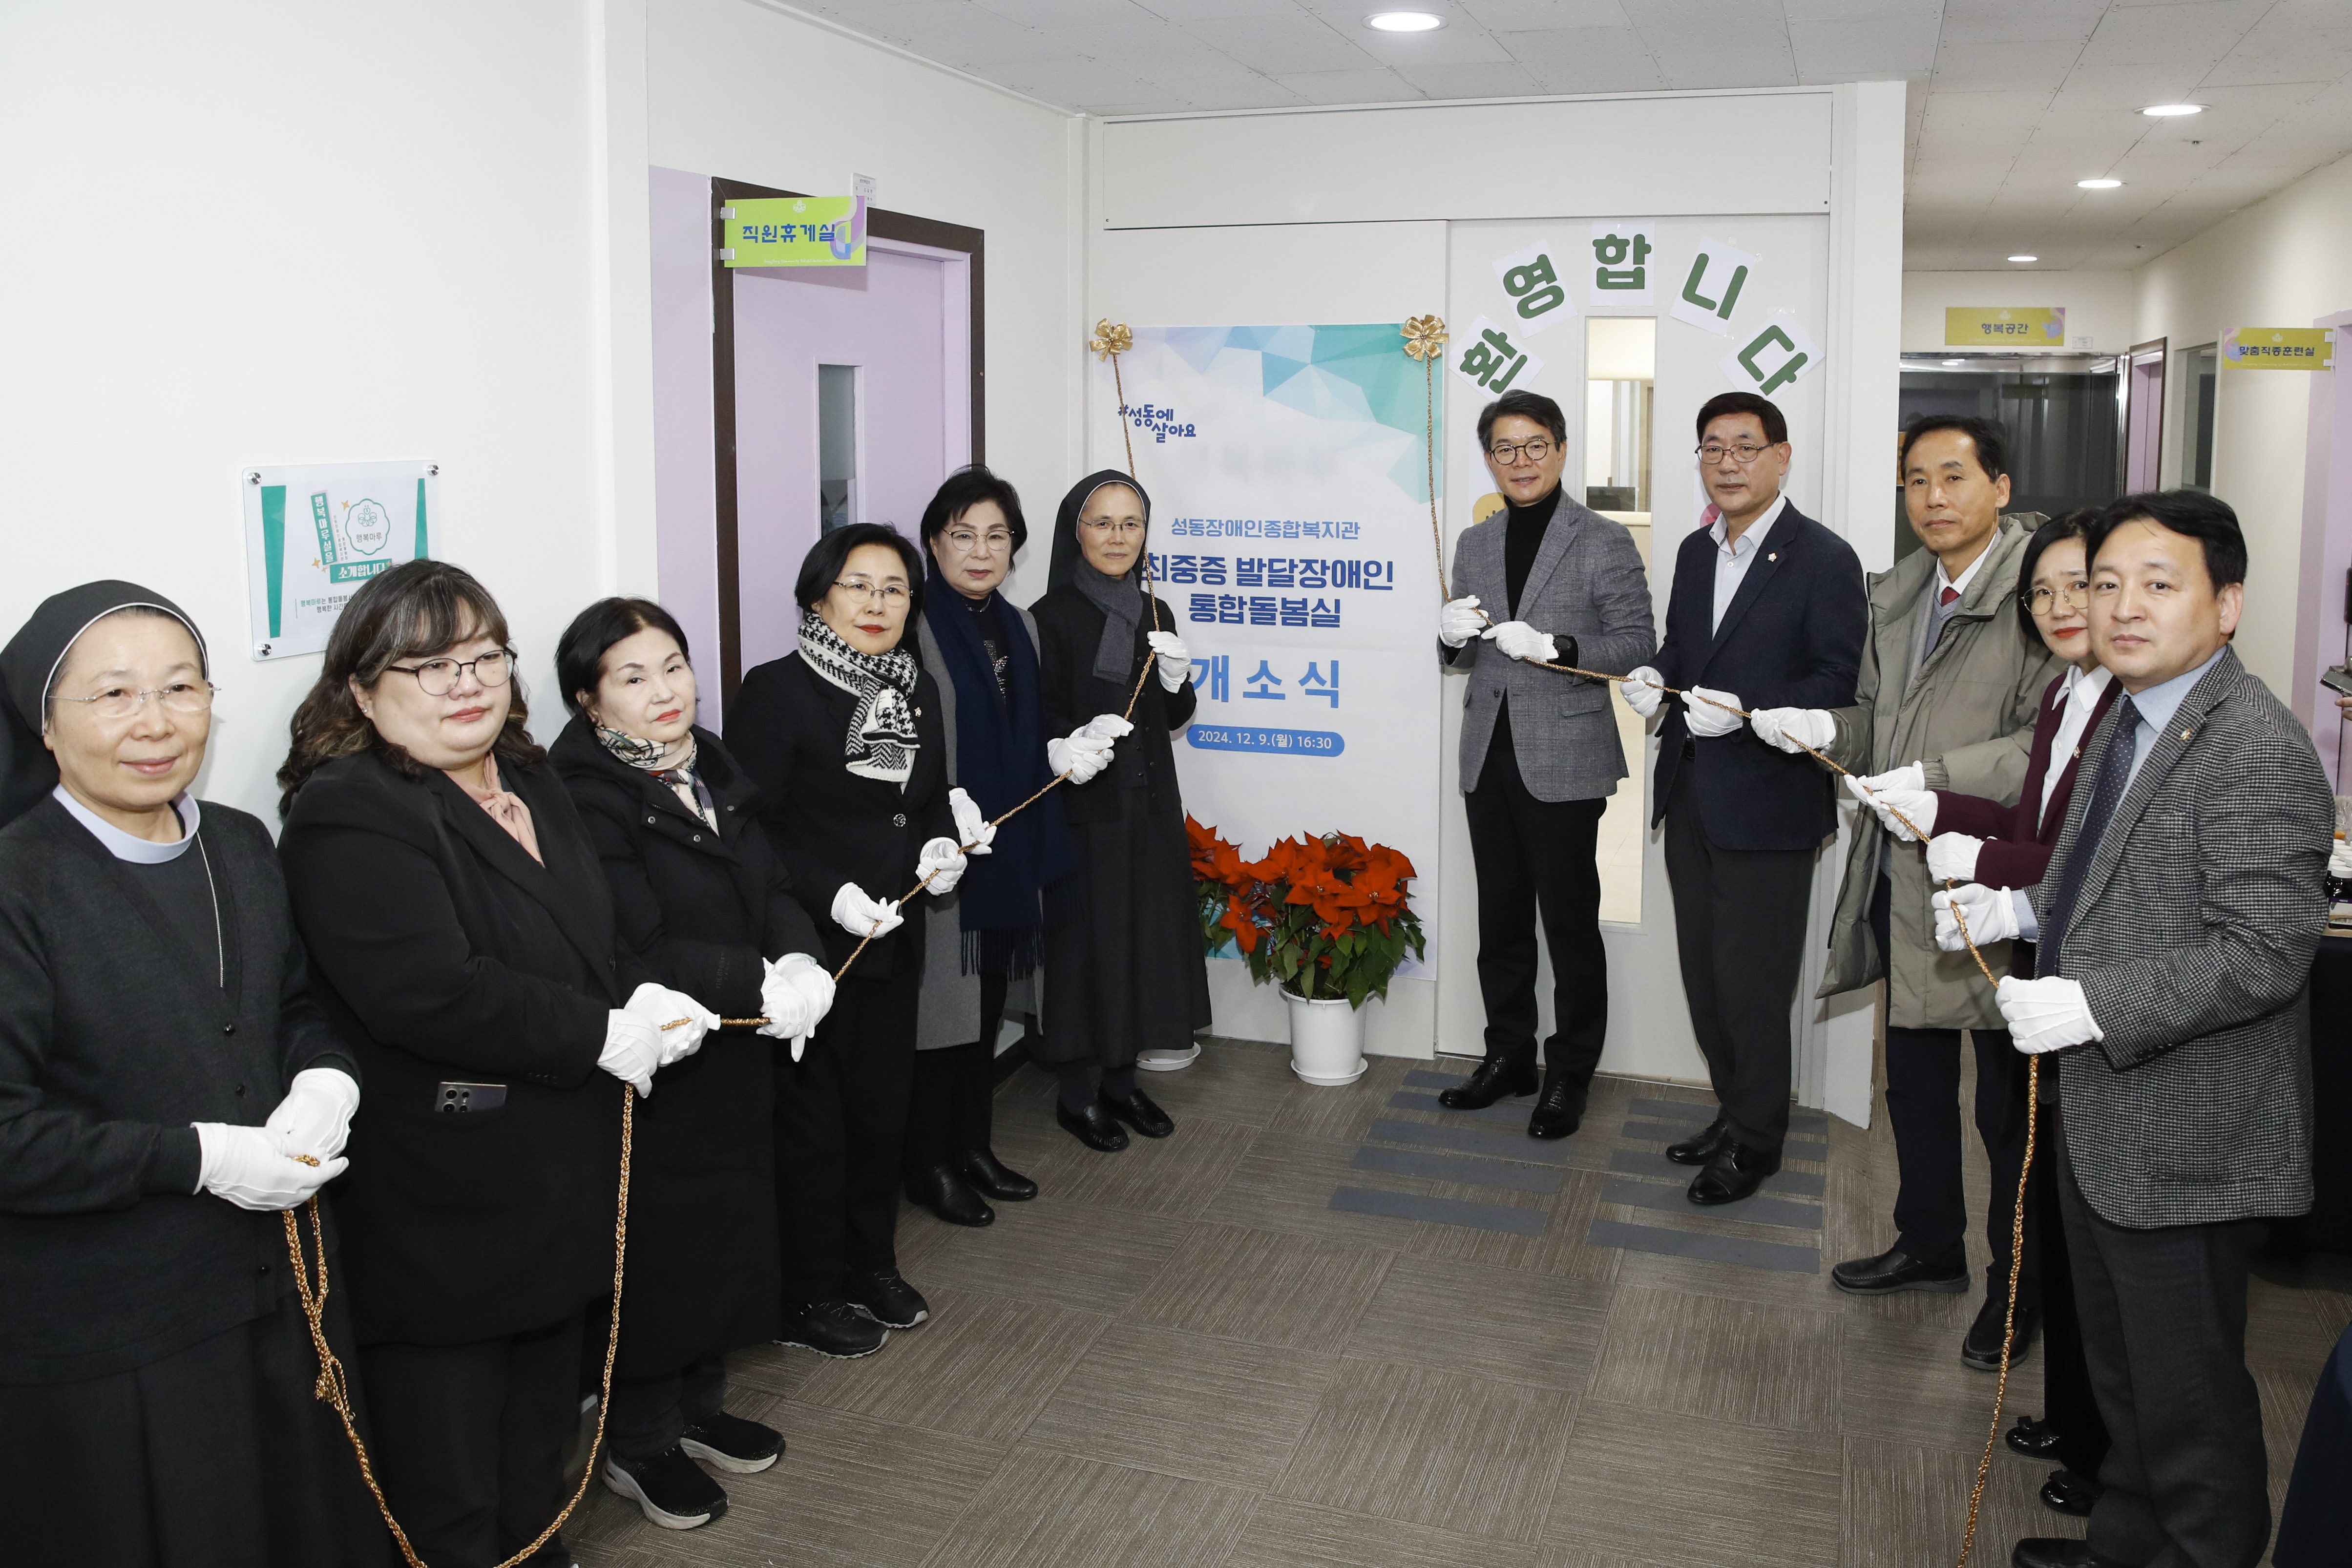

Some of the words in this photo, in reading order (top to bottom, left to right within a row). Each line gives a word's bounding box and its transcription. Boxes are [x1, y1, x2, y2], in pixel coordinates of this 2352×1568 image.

[742, 223, 835, 243] 직원휴게실
[1460, 233, 1808, 396] 환영합니다
[1981, 323, 2029, 335] 행복공간
[2239, 346, 2315, 356] 맞춤직종훈련실
[1151, 422, 1196, 443] 살아요
[356, 532, 382, 543] 행복마루
[1171, 517, 1361, 540] 성동장애인종합복지관
[1142, 552, 1227, 585] 최중증
[1236, 558, 1393, 590] 발달장애인
[1188, 593, 1341, 628] 통합돌봄실
[1198, 730, 1232, 744] 2024.
[1237, 732, 1255, 745] 12.
[1259, 733, 1293, 748] 9.(월)
[1297, 735, 1332, 750] 16:30
